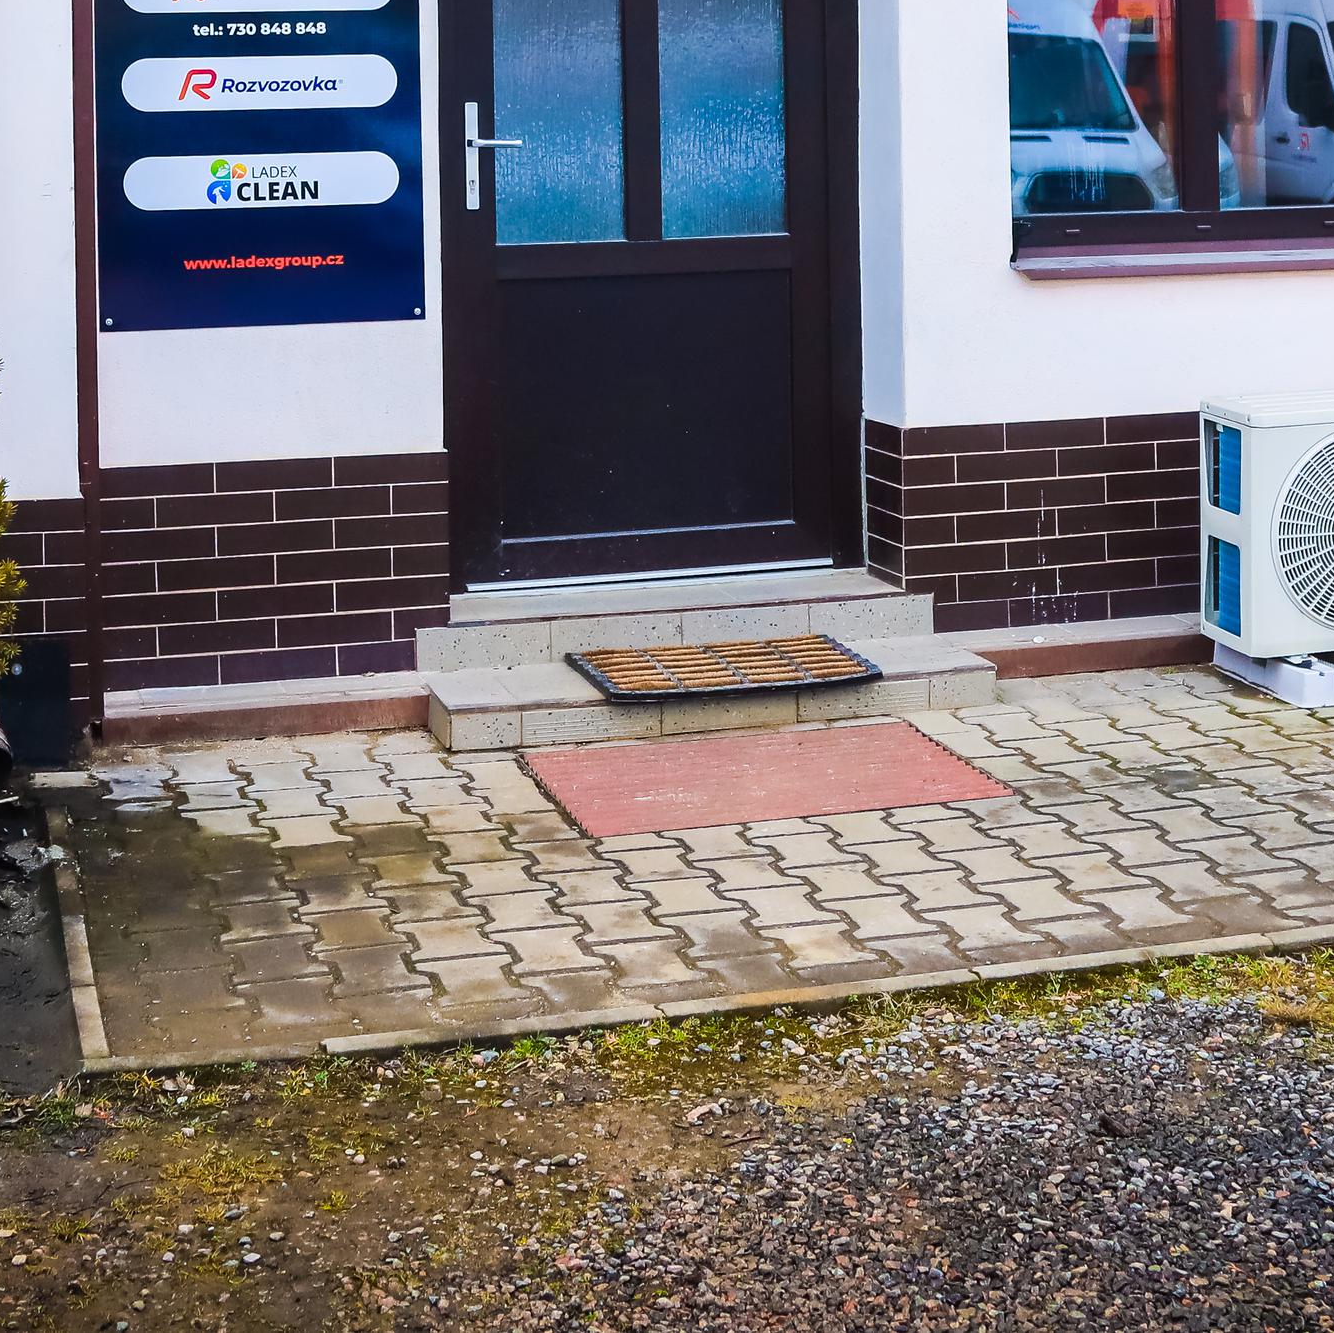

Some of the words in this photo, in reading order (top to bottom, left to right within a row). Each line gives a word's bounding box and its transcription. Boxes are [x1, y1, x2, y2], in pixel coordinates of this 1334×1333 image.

[192, 22, 223, 36] tel.:
[226, 22, 257, 36] 730
[260, 22, 292, 35] 848
[295, 21, 327, 35] 848
[221, 75, 338, 93] Rozvozovka
[251, 165, 298, 179] LADEX
[236, 180, 320, 202] CLEAN
[183, 254, 344, 270] www.ladexgroup.cz
